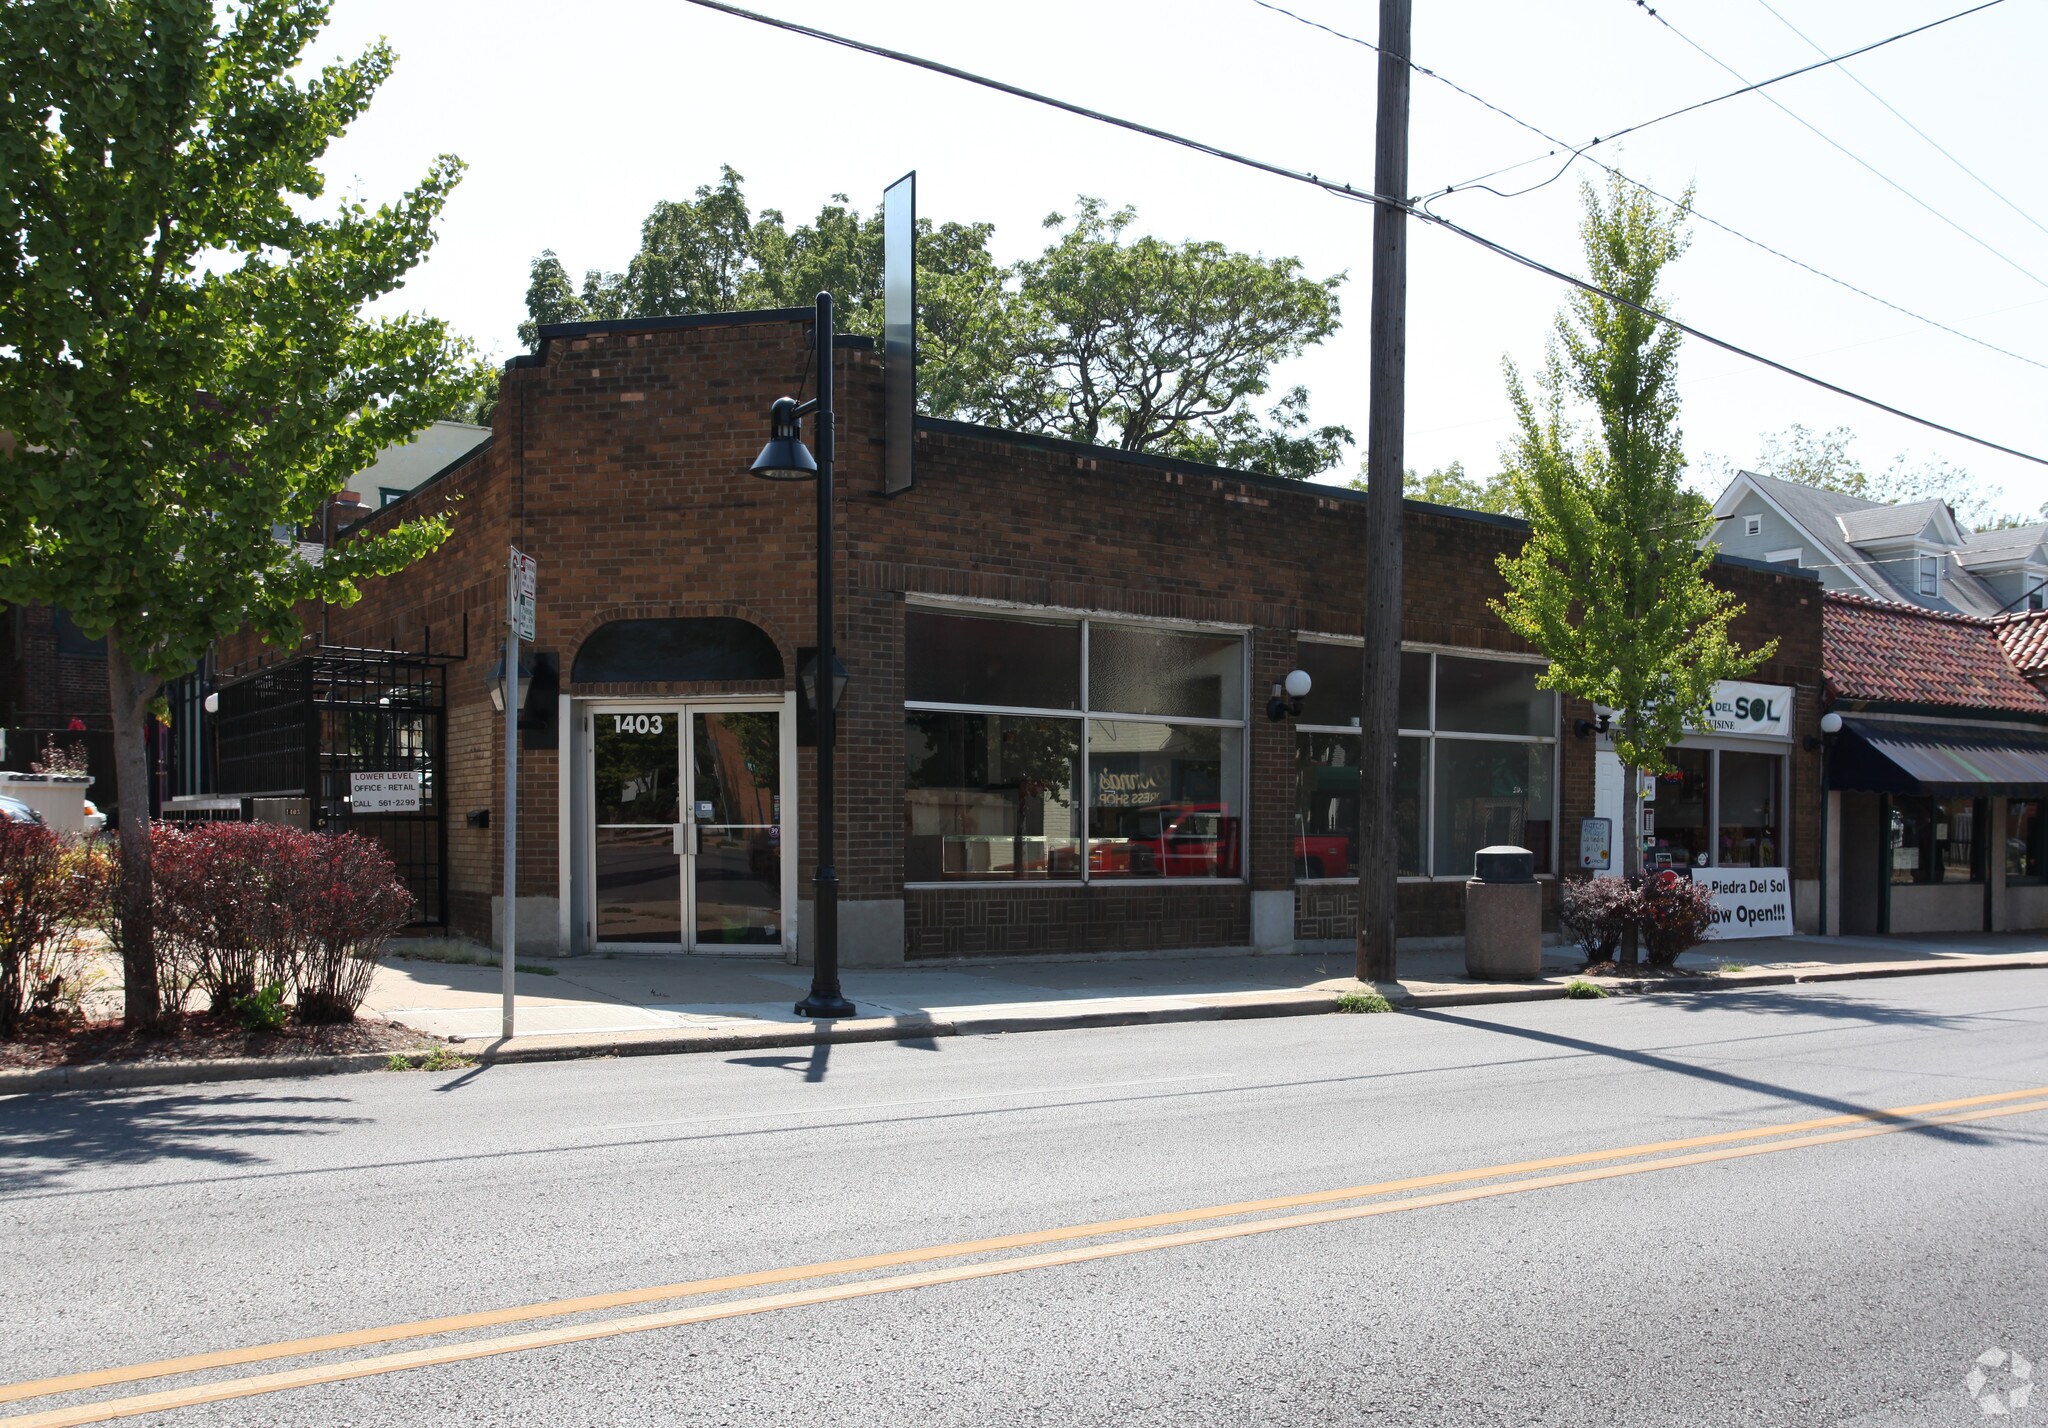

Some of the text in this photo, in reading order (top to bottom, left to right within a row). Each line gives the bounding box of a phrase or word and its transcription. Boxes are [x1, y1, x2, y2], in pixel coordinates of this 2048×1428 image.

[1715, 702, 1734, 713] DEL
[1735, 697, 1781, 722] SOL
[613, 715, 663, 734] 1403
[355, 772, 414, 781] LOWER LEVEL
[354, 784, 382, 792] OFFICE
[353, 799, 416, 808] CALL 561-2299
[1711, 880, 1746, 894] Piedra
[1749, 880, 1767, 893] Del
[1770, 880, 1786, 892] Sol
[1709, 904, 1785, 927] ow Open!!!
